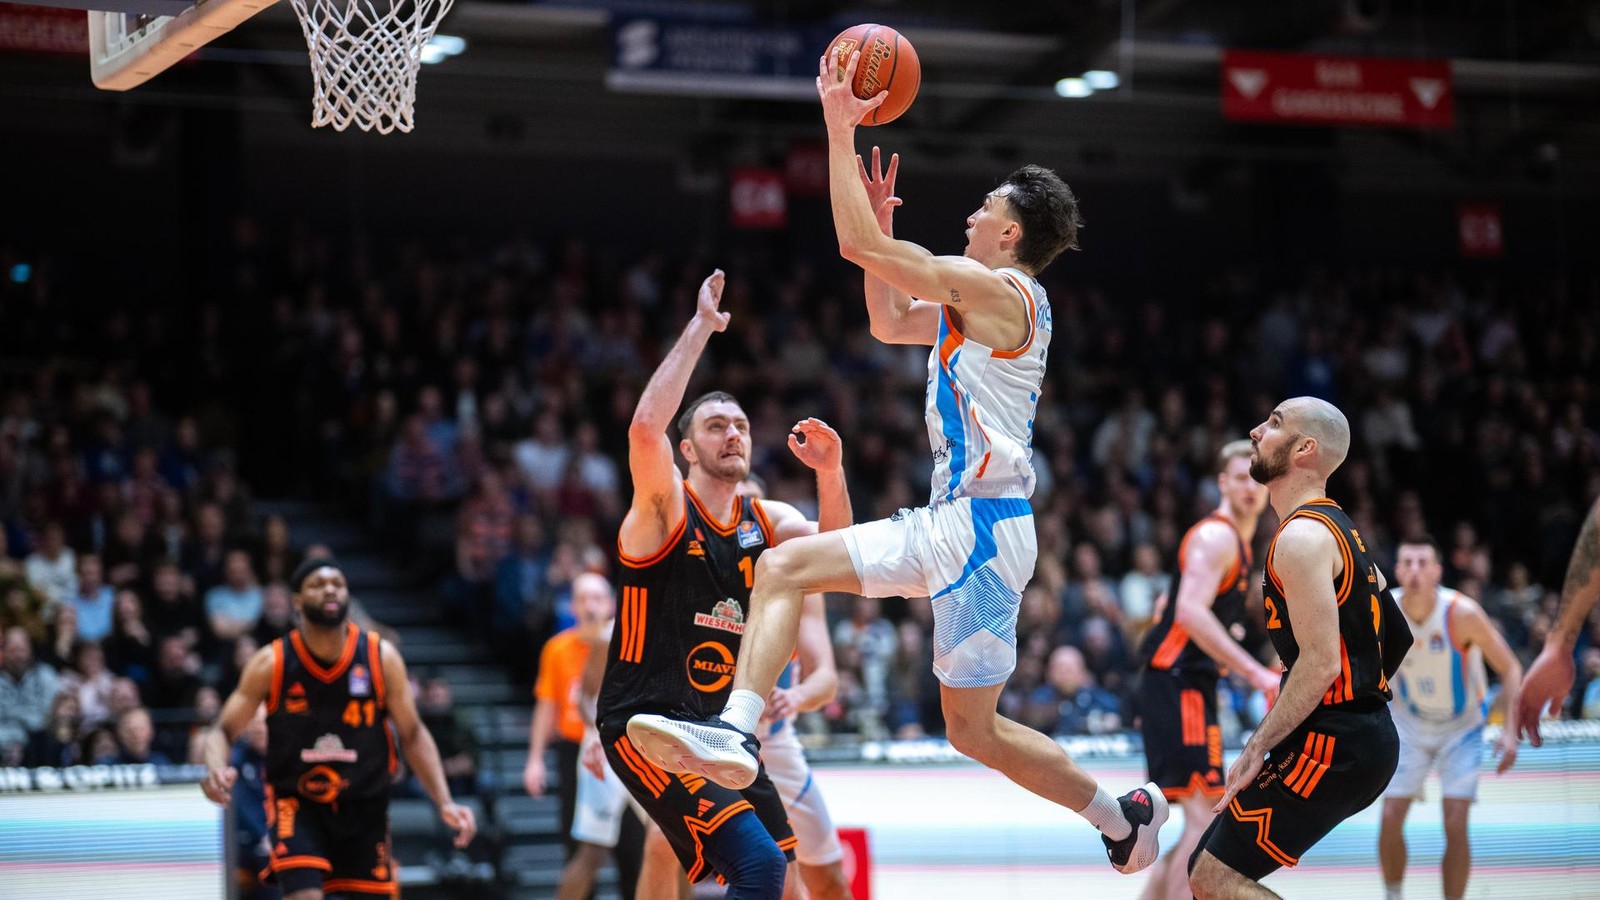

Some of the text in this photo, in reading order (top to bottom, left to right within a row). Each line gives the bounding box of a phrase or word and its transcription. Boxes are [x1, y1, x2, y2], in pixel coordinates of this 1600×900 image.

[860, 37, 891, 100] Baden
[697, 615, 744, 633] WIESENH
[1265, 596, 1282, 629] 2
[693, 659, 736, 676] MIAVI
[342, 700, 376, 728] 41
